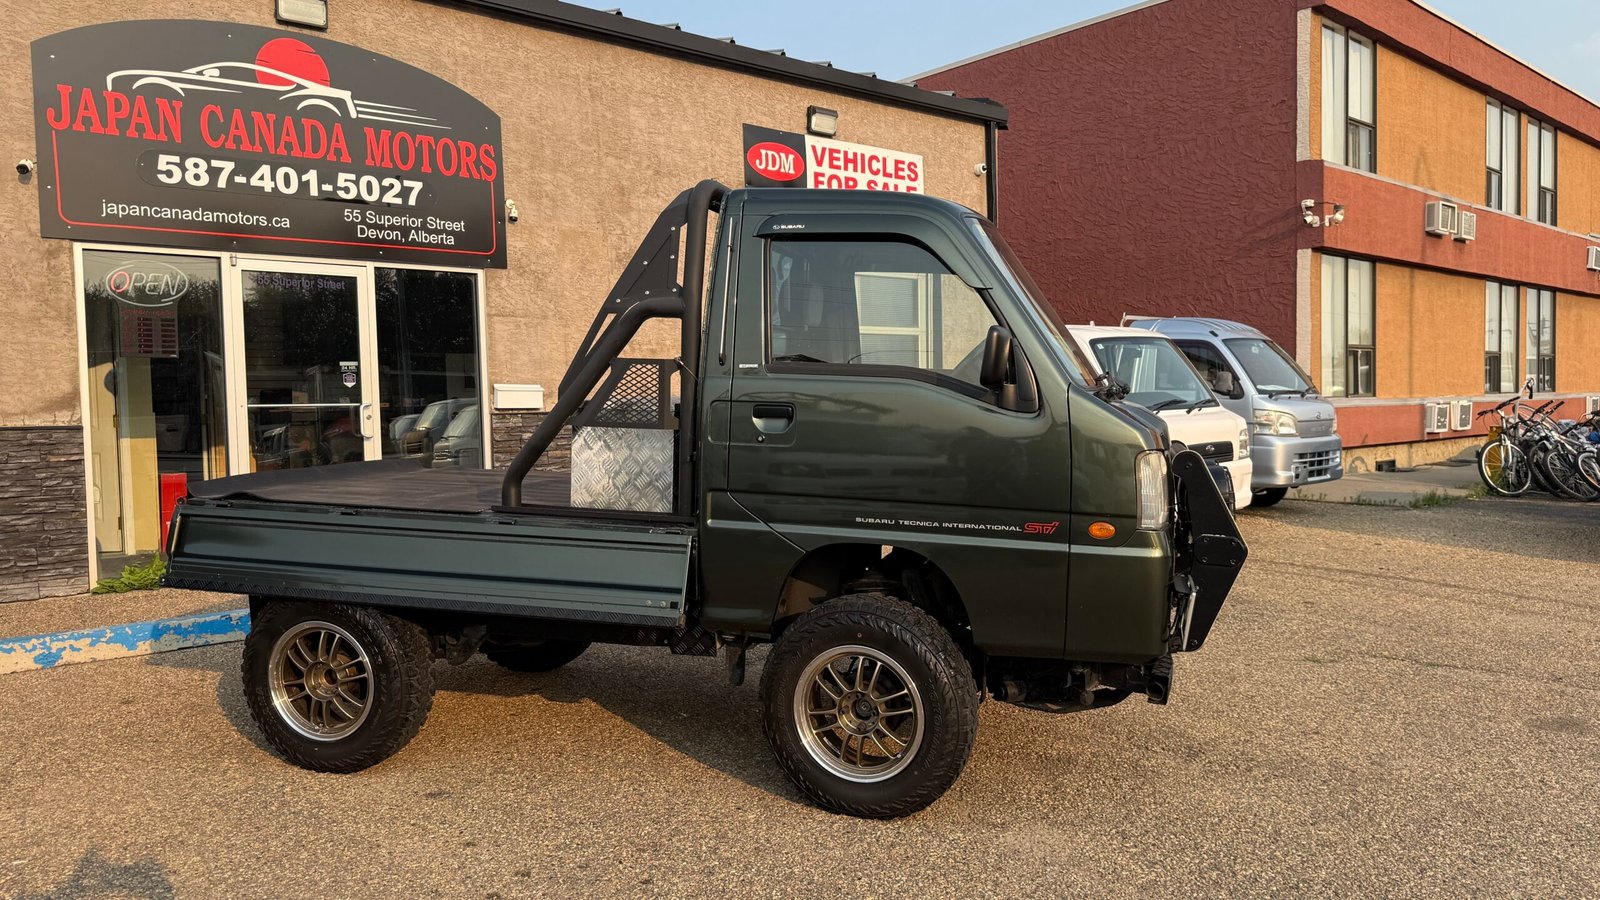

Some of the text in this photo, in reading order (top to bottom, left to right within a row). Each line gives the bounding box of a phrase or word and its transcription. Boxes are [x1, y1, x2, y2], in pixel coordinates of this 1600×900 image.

[46, 84, 497, 183] JAPAN CANADA MOTORS
[755, 149, 795, 174] JDM
[811, 145, 919, 182] VEHICLES
[156, 154, 424, 206] 587-401-5027
[101, 199, 290, 229] japancanadamotors.ca
[344, 209, 466, 232] 55 Superior Street
[357, 225, 455, 246] Devon, Alberta
[110, 271, 181, 296] OPEN
[272, 275, 316, 289] Superior
[317, 278, 346, 290] Street
[855, 517, 895, 525] SUBARU
[942, 522, 1022, 532] INTERNATIONAL
